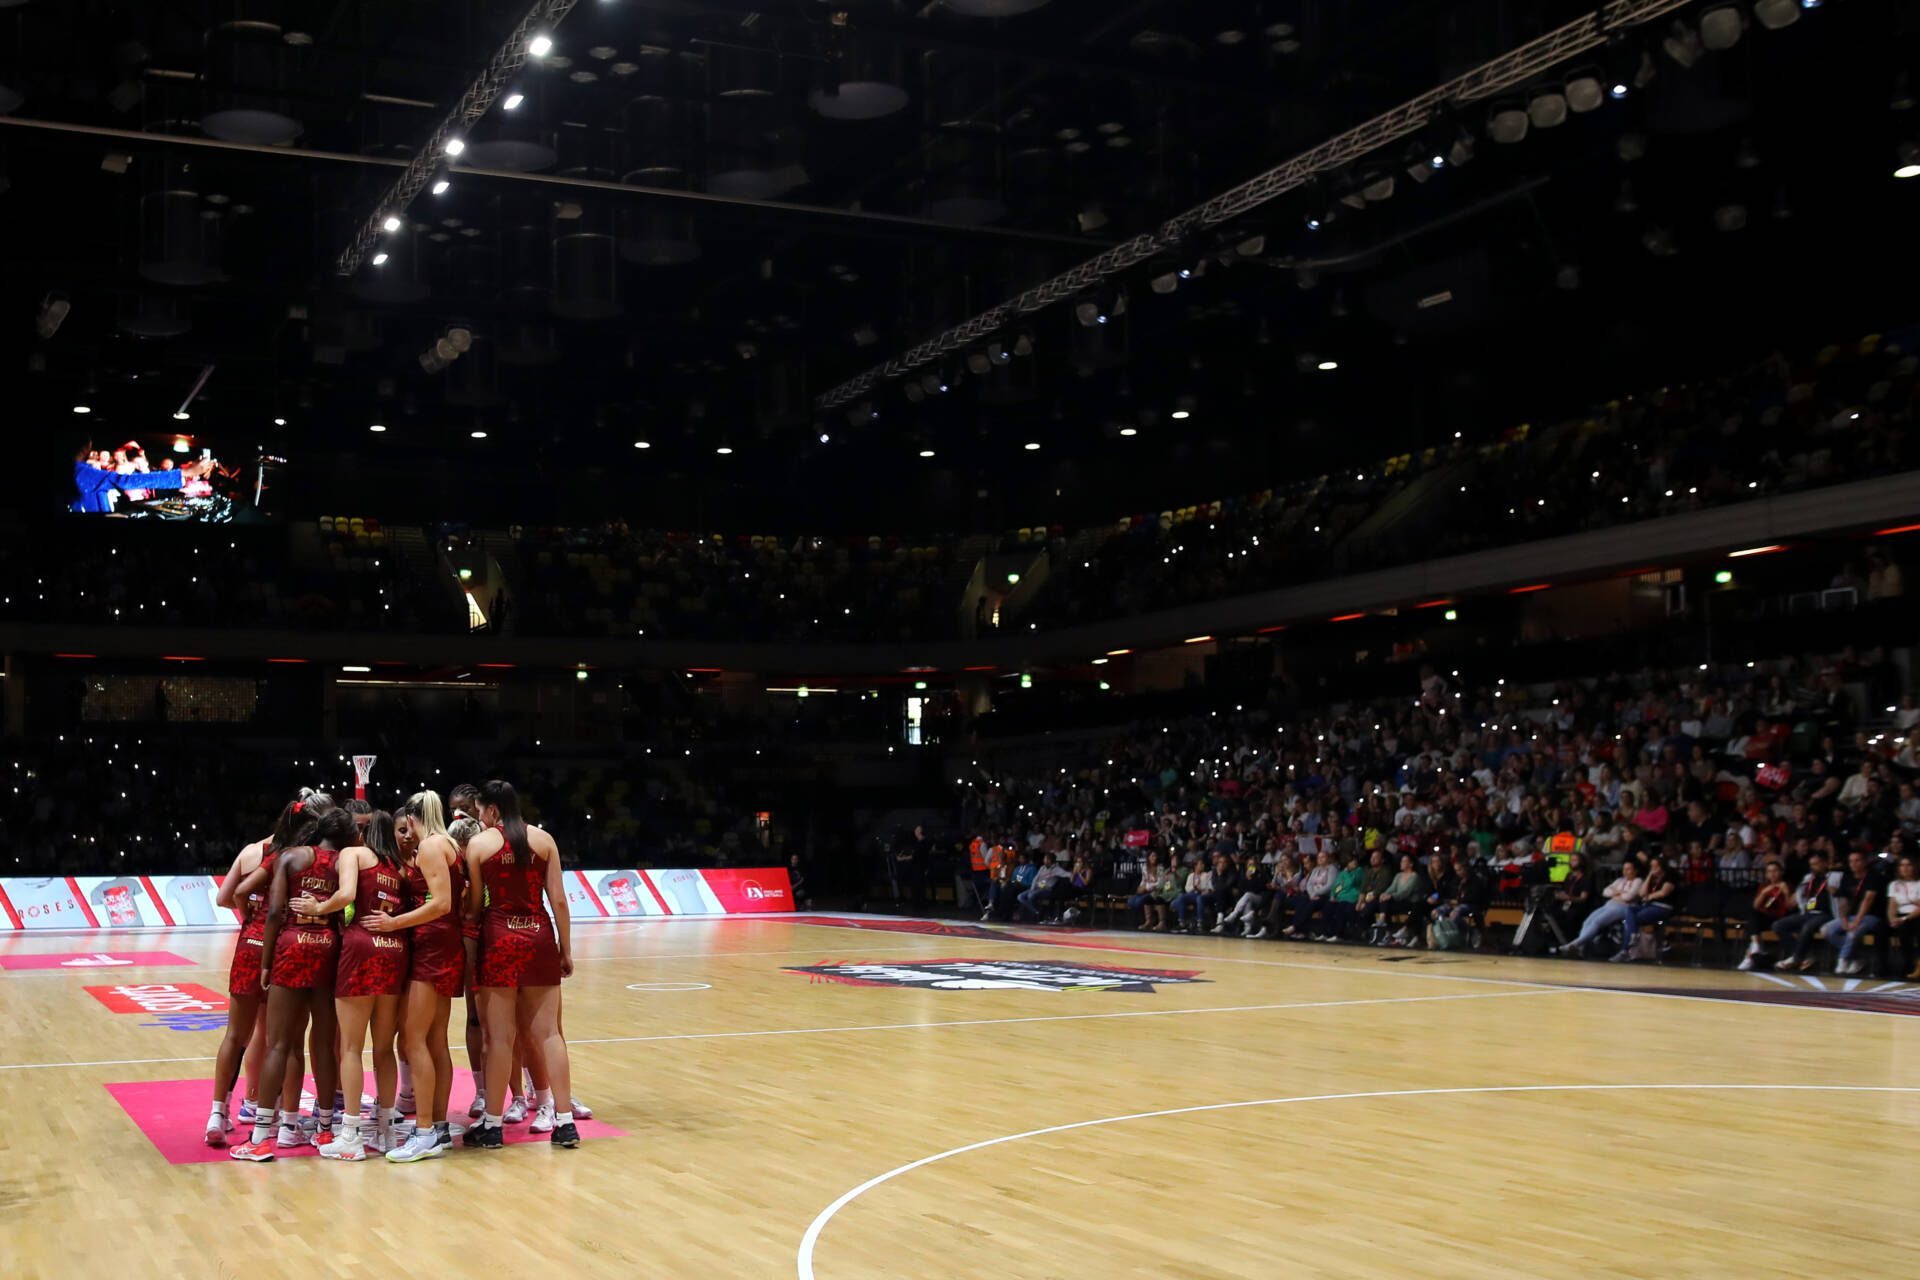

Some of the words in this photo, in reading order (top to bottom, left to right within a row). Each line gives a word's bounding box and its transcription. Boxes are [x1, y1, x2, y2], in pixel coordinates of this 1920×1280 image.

[17, 899, 75, 920] ROSES
[507, 915, 540, 933] Vitality
[297, 932, 332, 949] Vitality
[372, 935, 404, 952] Vitality
